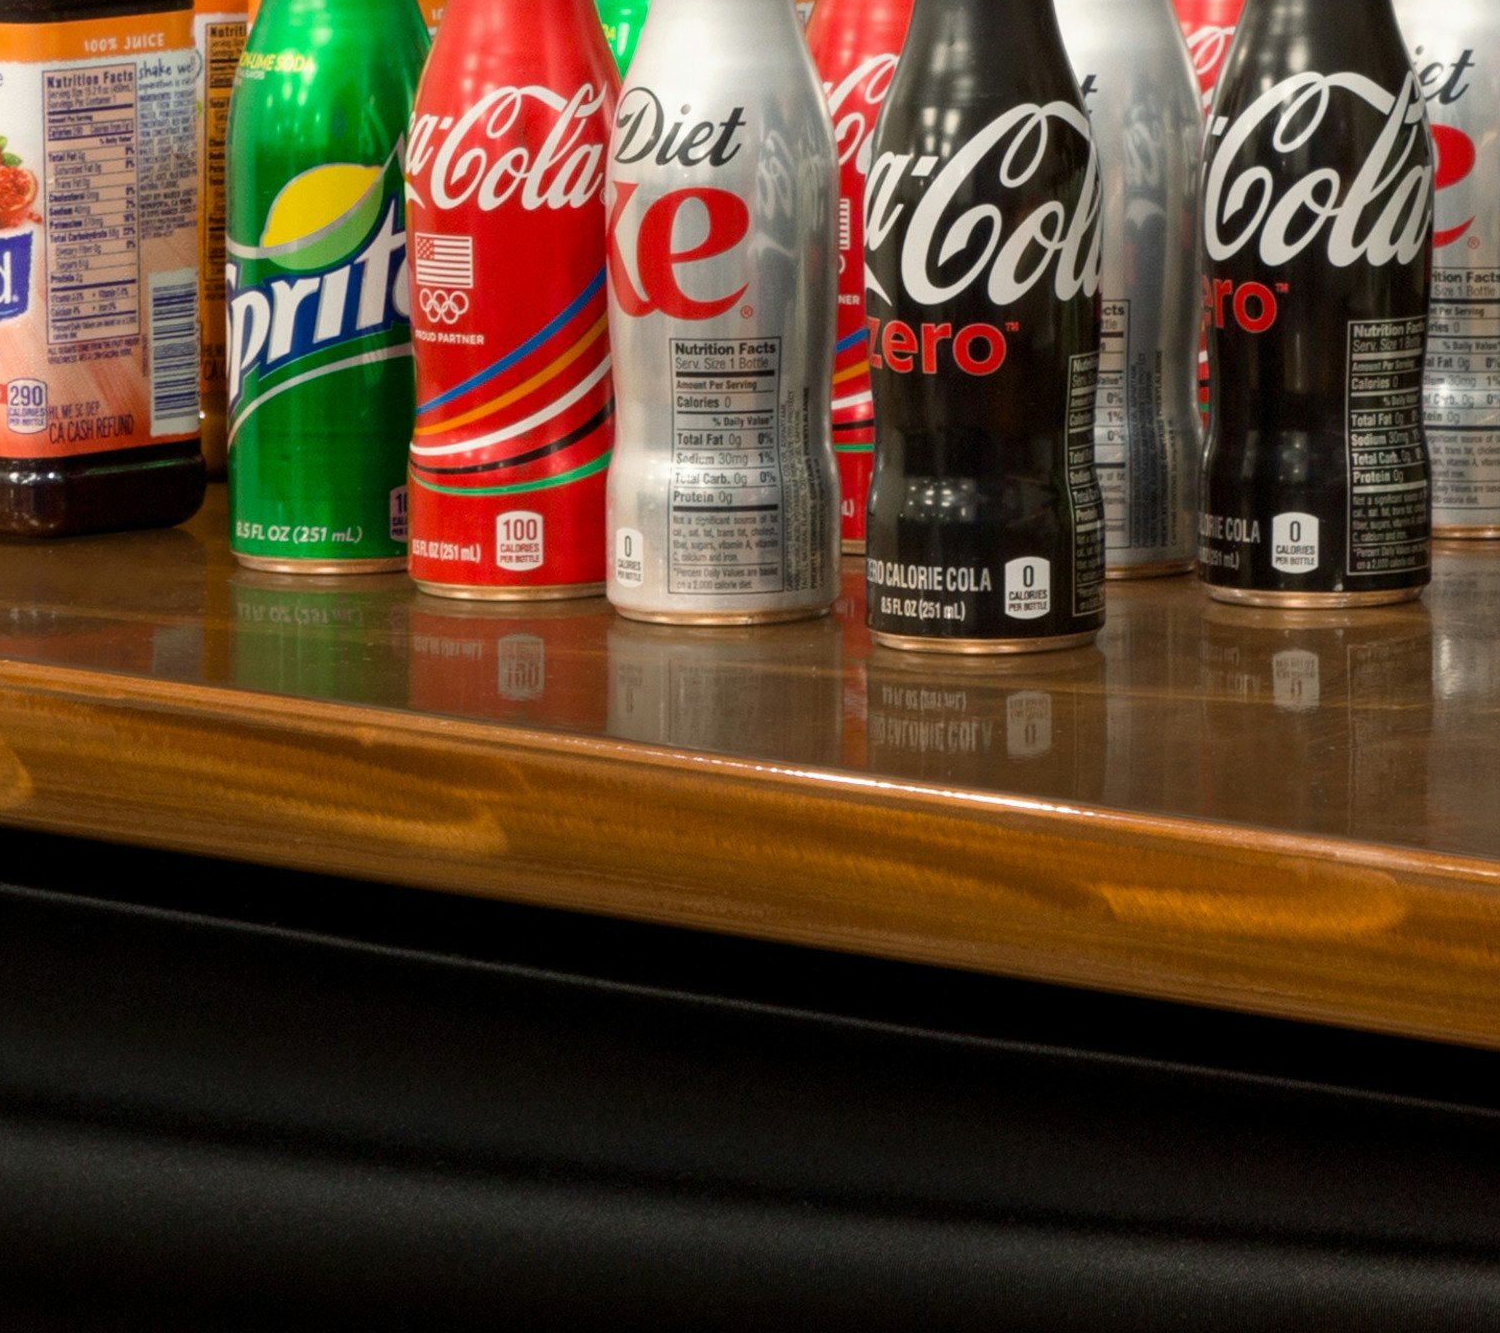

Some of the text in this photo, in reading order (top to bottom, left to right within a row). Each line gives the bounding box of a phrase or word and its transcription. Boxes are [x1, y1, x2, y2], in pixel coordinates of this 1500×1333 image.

[210, 25, 248, 37] Nutriti
[84, 36, 117, 52] 100%
[124, 32, 165, 50] JUICE
[138, 57, 172, 80] shake
[46, 69, 134, 89] Nutrition Facts
[614, 86, 747, 167] Diet
[405, 80, 608, 212] a-Cola
[1466, 285, 1495, 296] Bottle
[226, 199, 410, 402] prit
[1454, 306, 1485, 317] Serving
[1353, 323, 1404, 338] Nutrition
[438, 333, 484, 345] PARTNER
[1352, 339, 1378, 352] Serv.
[675, 341, 776, 356] Nutrition Facts
[675, 356, 769, 370] Serv. Size 1 Bottle
[1437, 356, 1453, 368] Fat
[676, 380, 758, 391] Amount Per Serving
[1351, 377, 1390, 390] Calories
[9, 385, 43, 407] 290
[676, 395, 731, 408] Calories 0
[1106, 392, 1124, 405] 0%
[8, 407, 46, 417] CALORIES
[1107, 411, 1124, 423] 1%
[723, 416, 745, 428] Daily
[1350, 412, 1393, 427] Total Fat
[49, 413, 134, 444] CA CASH REFUND
[677, 432, 774, 448] Total Fat 0g 0%
[1351, 433, 1386, 446] Sodium
[676, 452, 775, 467] Sodium 30mg 1%
[1352, 452, 1377, 466] Total
[703, 472, 731, 484] Carb.
[734, 473, 748, 486] 0g
[759, 471, 776, 483] 0%
[1352, 471, 1391, 484] Protein
[673, 490, 733, 504] Protein 0g
[251, 523, 265, 540] FL
[268, 524, 290, 542] OZ
[293, 524, 328, 544] (251
[332, 524, 364, 544] mL)
[501, 518, 538, 541] 100
[1225, 517, 1261, 544] COLA
[1289, 520, 1302, 542] 0
[500, 543, 540, 553] CALORIES
[624, 535, 632, 558] 0
[1275, 544, 1316, 555] CALORIES
[500, 554, 540, 564] PER BOTTLE
[1275, 556, 1316, 566] PER BOTTLE
[885, 561, 943, 591] CALORIE
[946, 566, 992, 592] COLA
[1022, 564, 1035, 588] 0
[1008, 588, 1048, 601] CALORIES
[893, 597, 903, 615] FL
[904, 599, 917, 617] OZ
[918, 598, 941, 621] (251
[943, 600, 966, 622] mL)
[1008, 602, 1048, 612] PER BOTTLE
